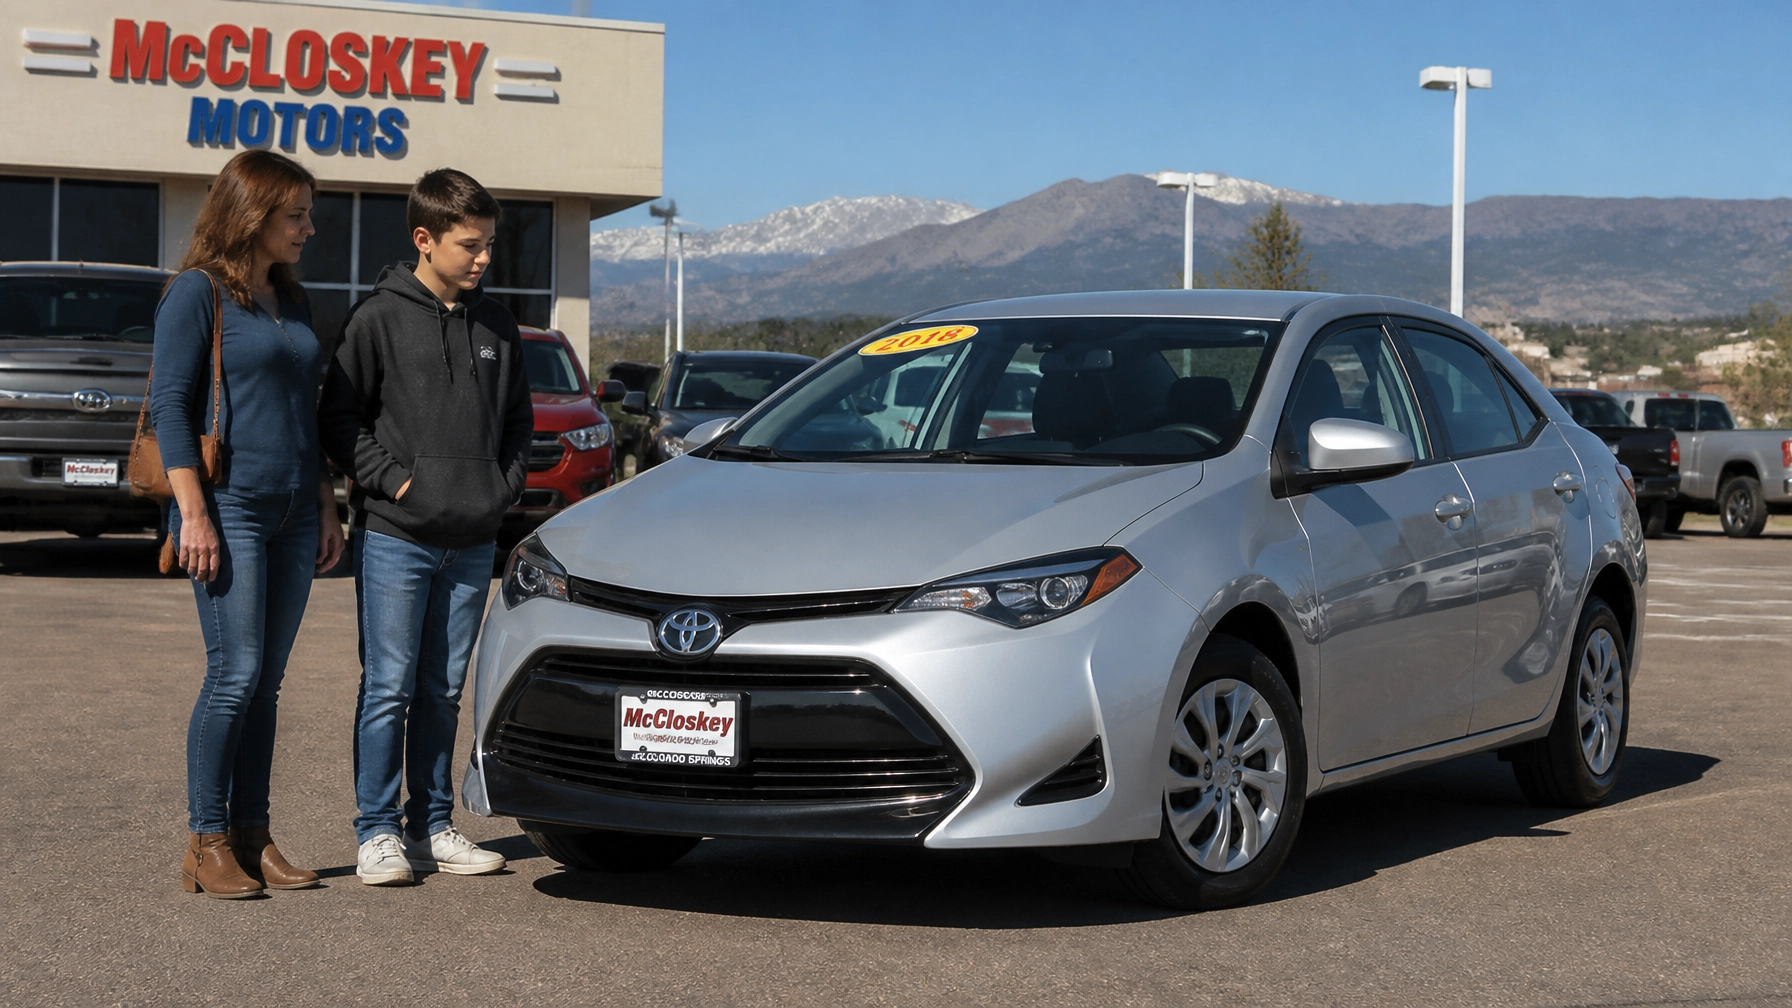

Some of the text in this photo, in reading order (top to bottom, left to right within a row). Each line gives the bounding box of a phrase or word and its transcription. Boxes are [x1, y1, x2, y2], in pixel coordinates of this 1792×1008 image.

[109, 18, 486, 100] McCLOSKEY
[187, 97, 407, 155] MOTORS
[623, 707, 734, 737] McCloskey
